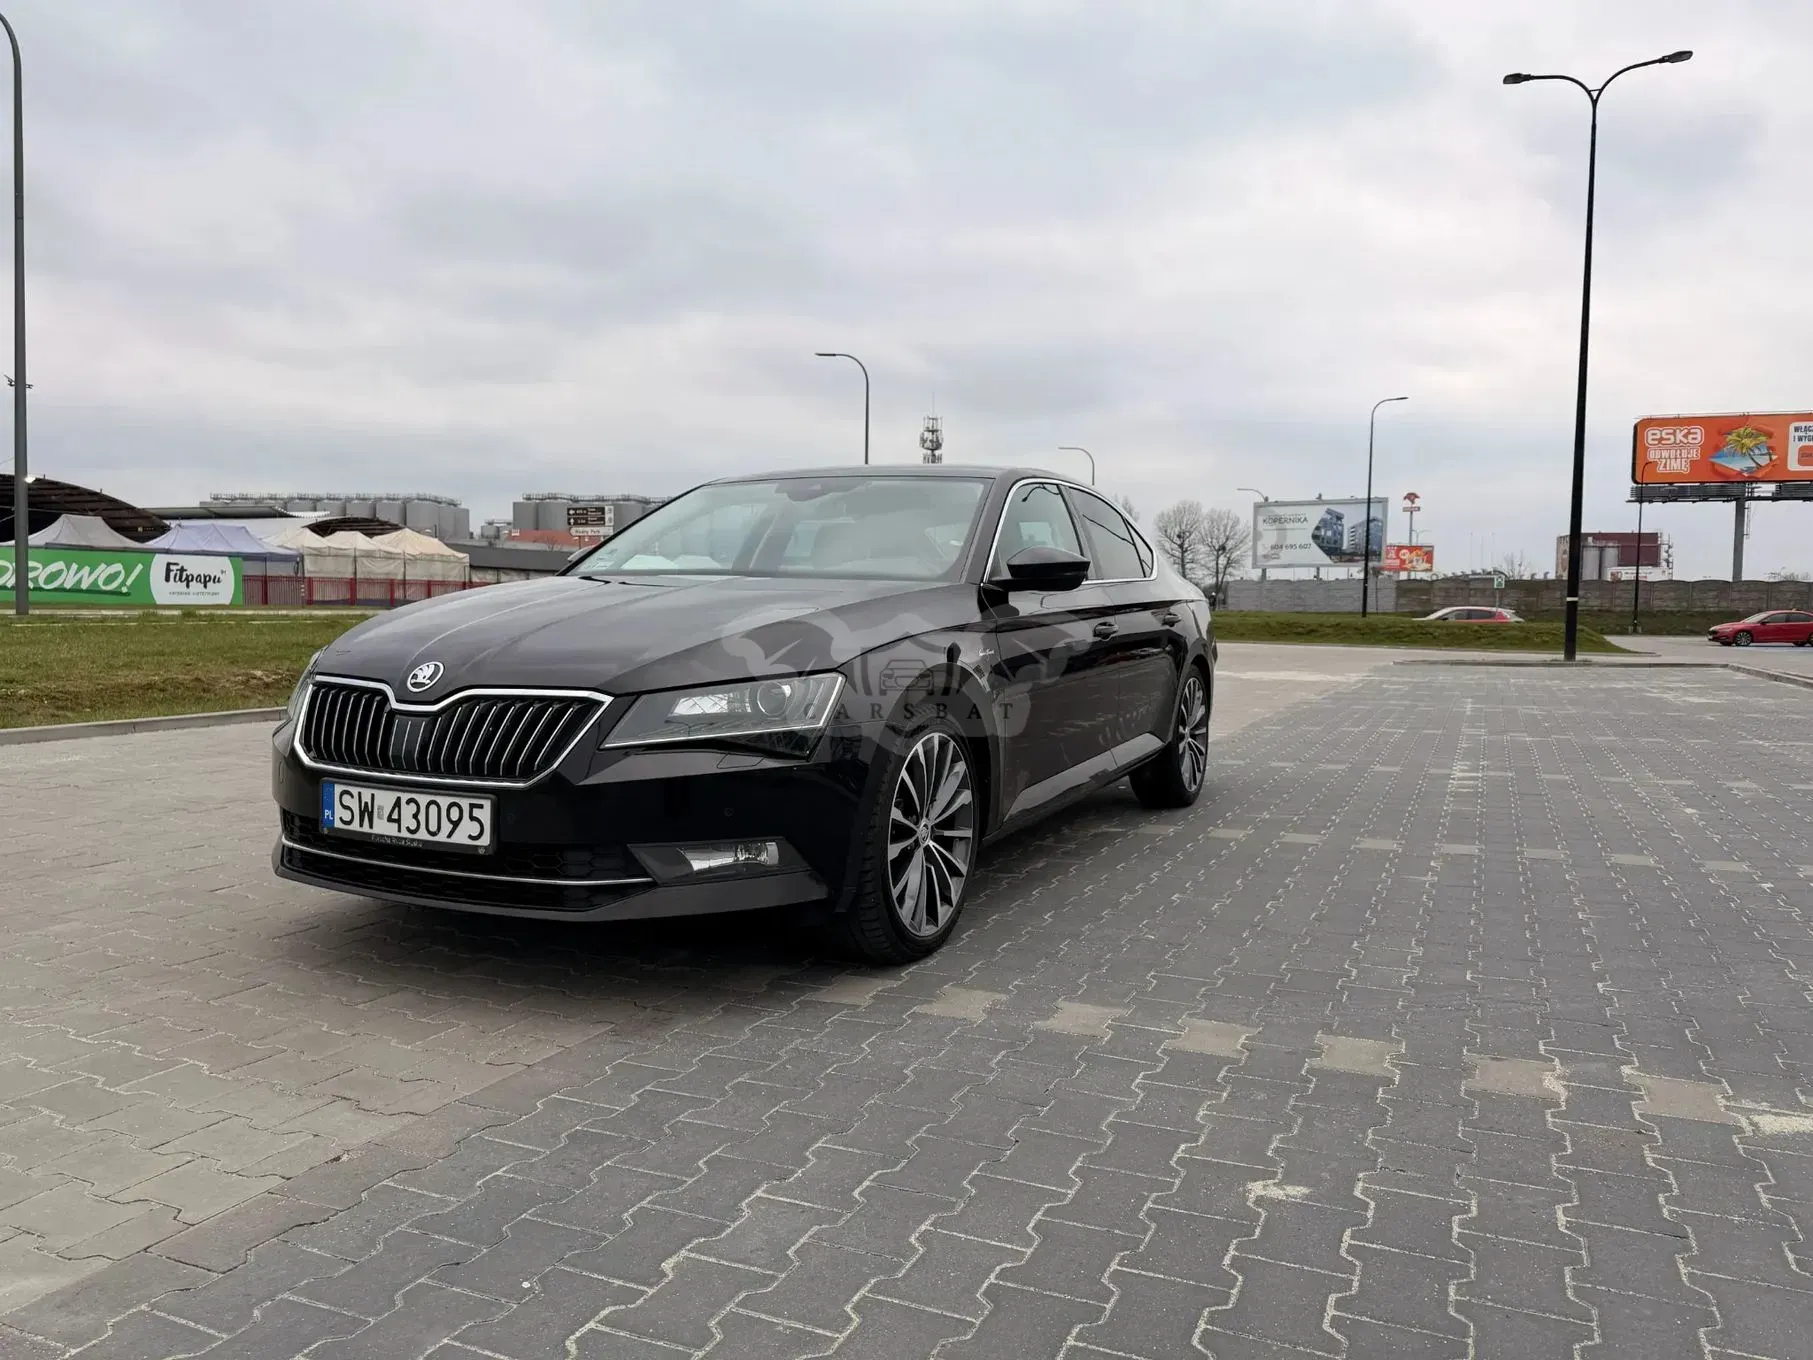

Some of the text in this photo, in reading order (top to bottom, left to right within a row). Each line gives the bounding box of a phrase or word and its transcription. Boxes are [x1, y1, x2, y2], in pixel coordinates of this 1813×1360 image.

[1793, 425, 1813, 434] WŁĄC
[1659, 458, 1689, 472] ZIMĘ
[1262, 516, 1308, 525] KOPERNIKA
[324, 809, 334, 820] PL
[339, 789, 485, 842] SW 43095
